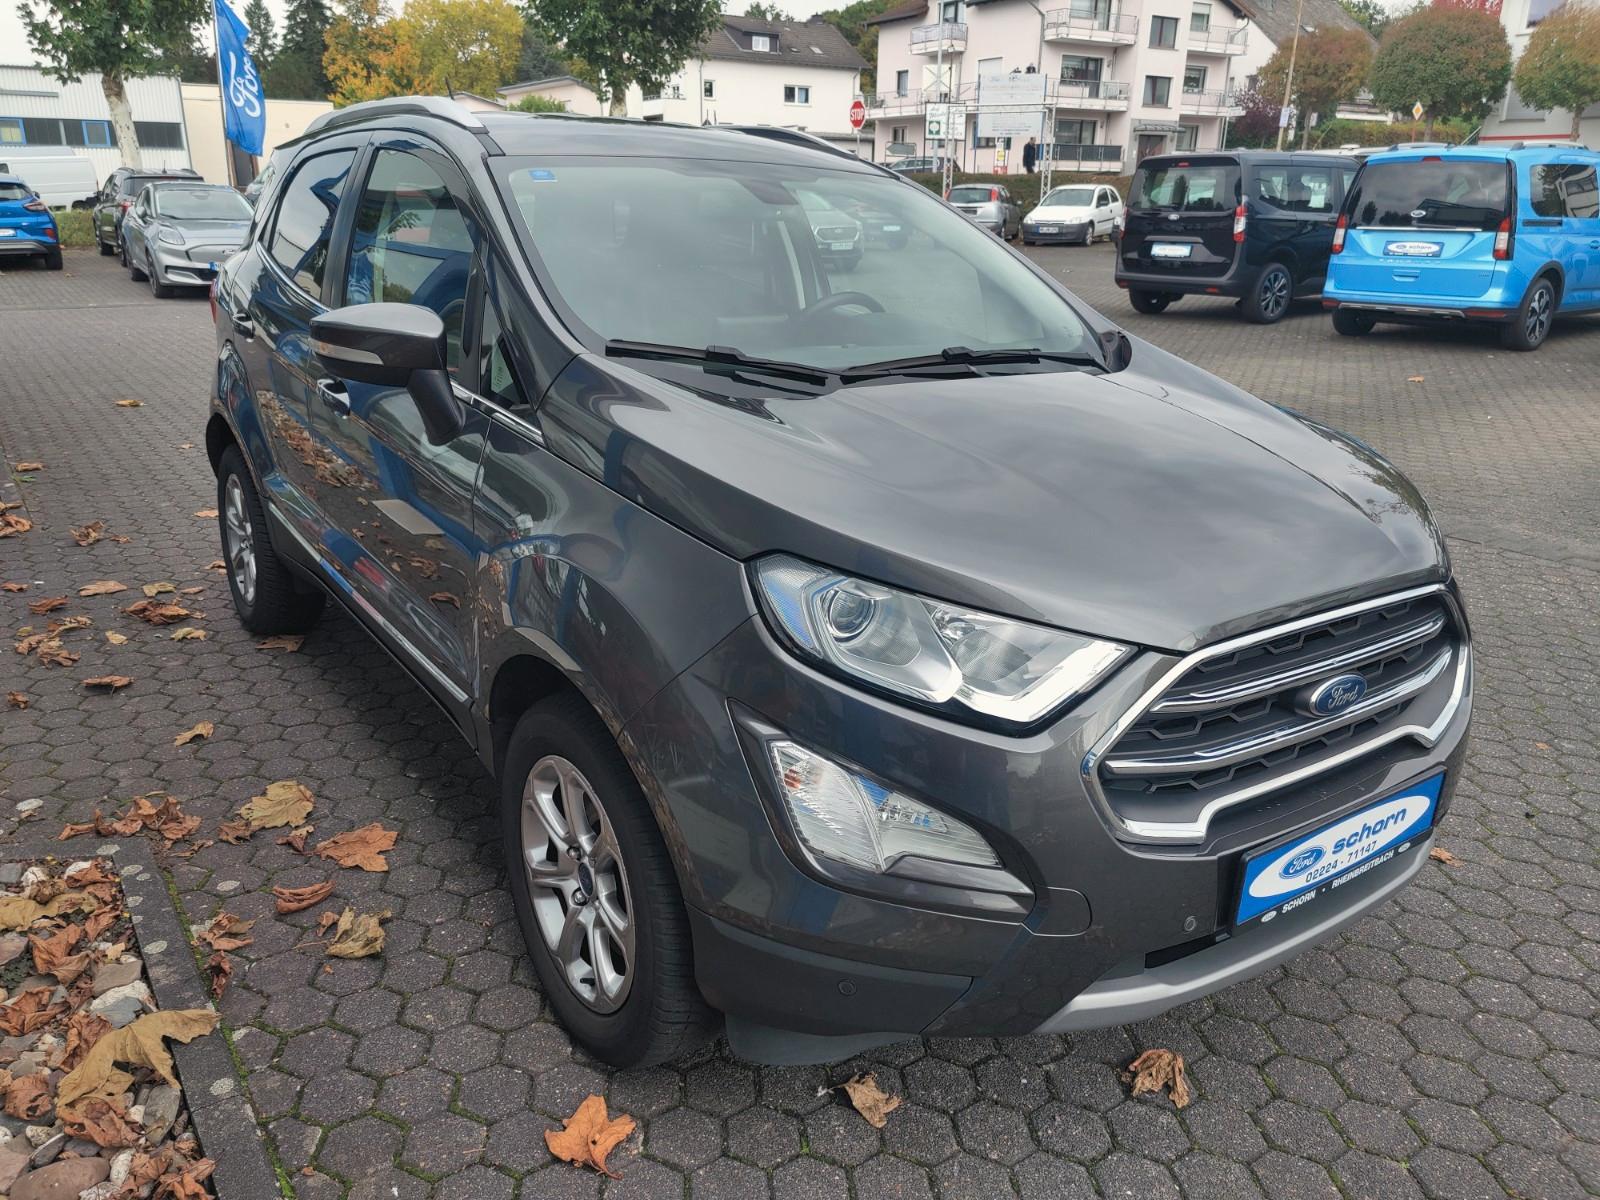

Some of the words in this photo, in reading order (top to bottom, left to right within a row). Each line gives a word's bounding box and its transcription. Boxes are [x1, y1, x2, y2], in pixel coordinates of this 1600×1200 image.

[229, 51, 261, 118] For
[850, 109, 865, 122] STOP
[1327, 682, 1360, 710] Ford
[1331, 808, 1407, 855] schorn
[1281, 889, 1317, 914] SCHORN
[1331, 849, 1395, 889] RHEINBREITBACH
[1289, 852, 1317, 873] Ford
[1305, 859, 1339, 883] 02224
[1347, 840, 1378, 864] 71147
